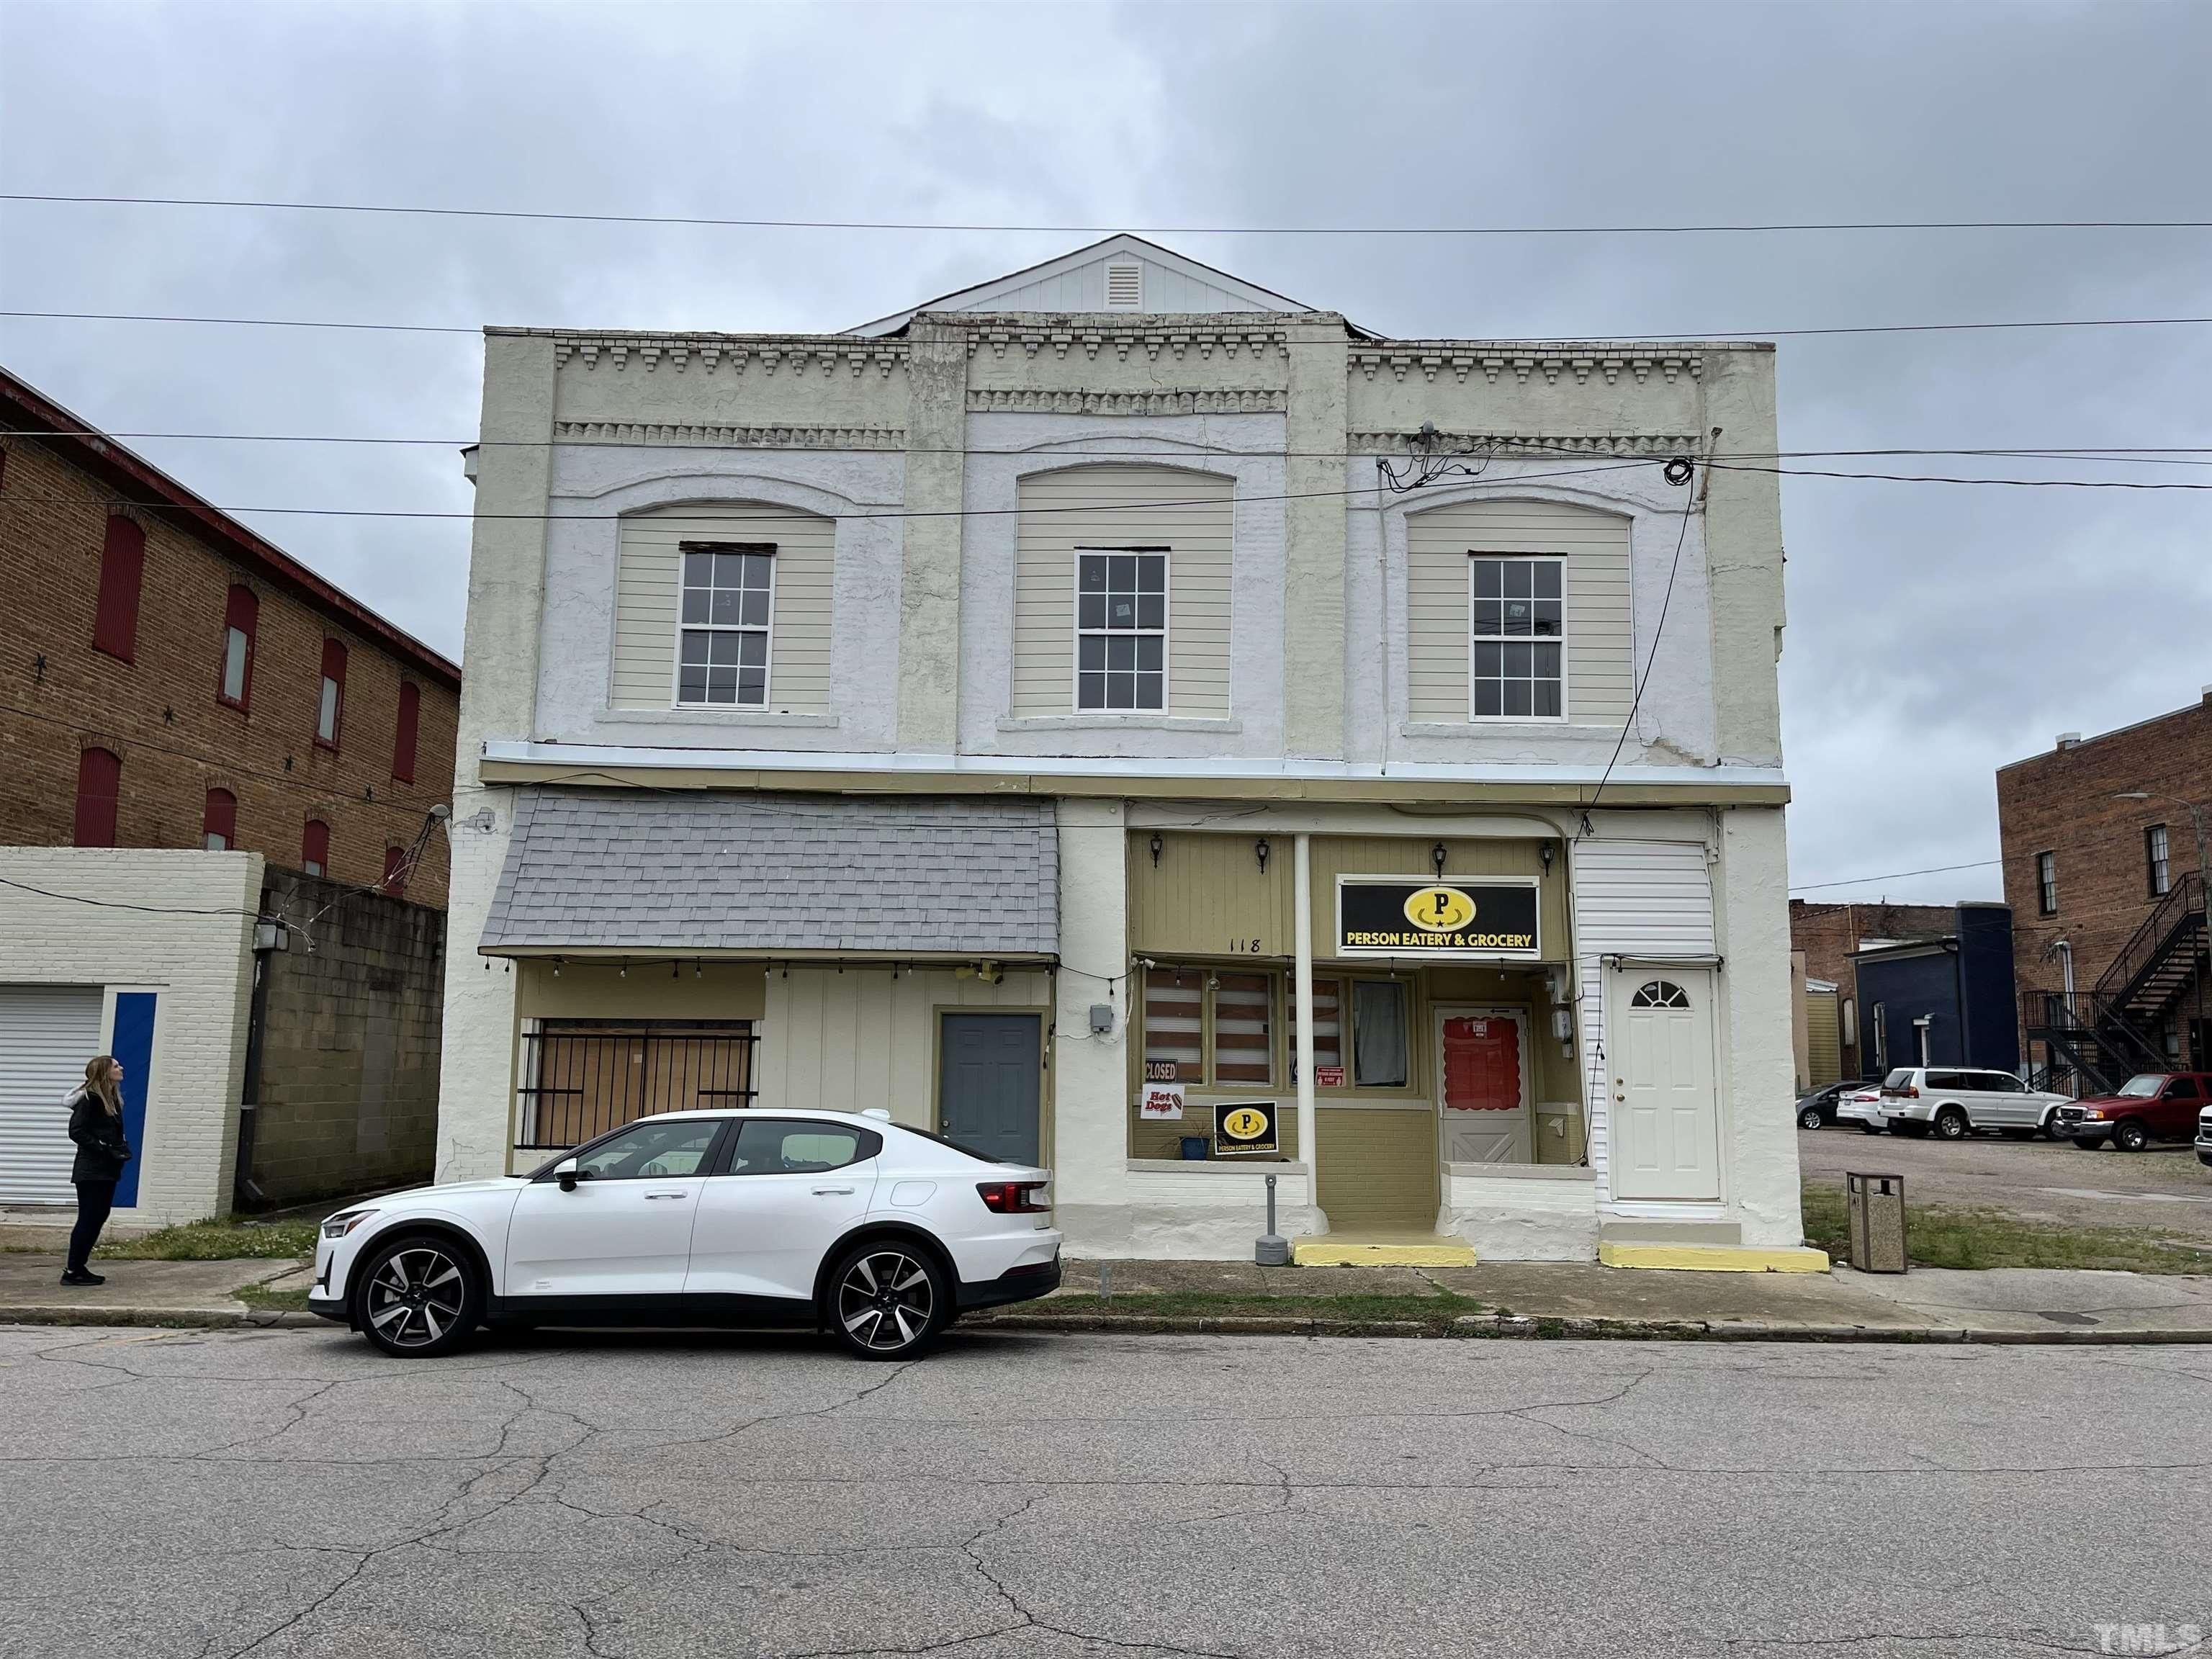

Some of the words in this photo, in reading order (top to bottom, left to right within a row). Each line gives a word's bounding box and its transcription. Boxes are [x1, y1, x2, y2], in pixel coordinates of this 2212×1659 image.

[1434, 894, 1449, 914] P
[1231, 938, 1261, 953] 118
[1347, 932, 1399, 945] PERSON
[1403, 932, 1452, 946] EATERY
[1455, 933, 1465, 946] &
[1467, 933, 1532, 948] GROCERY
[1146, 1063, 1176, 1079] CLOSED
[1150, 1092, 1171, 1101] Hot
[1145, 1100, 1172, 1112] Dogs
[1241, 1114, 1251, 1130] P
